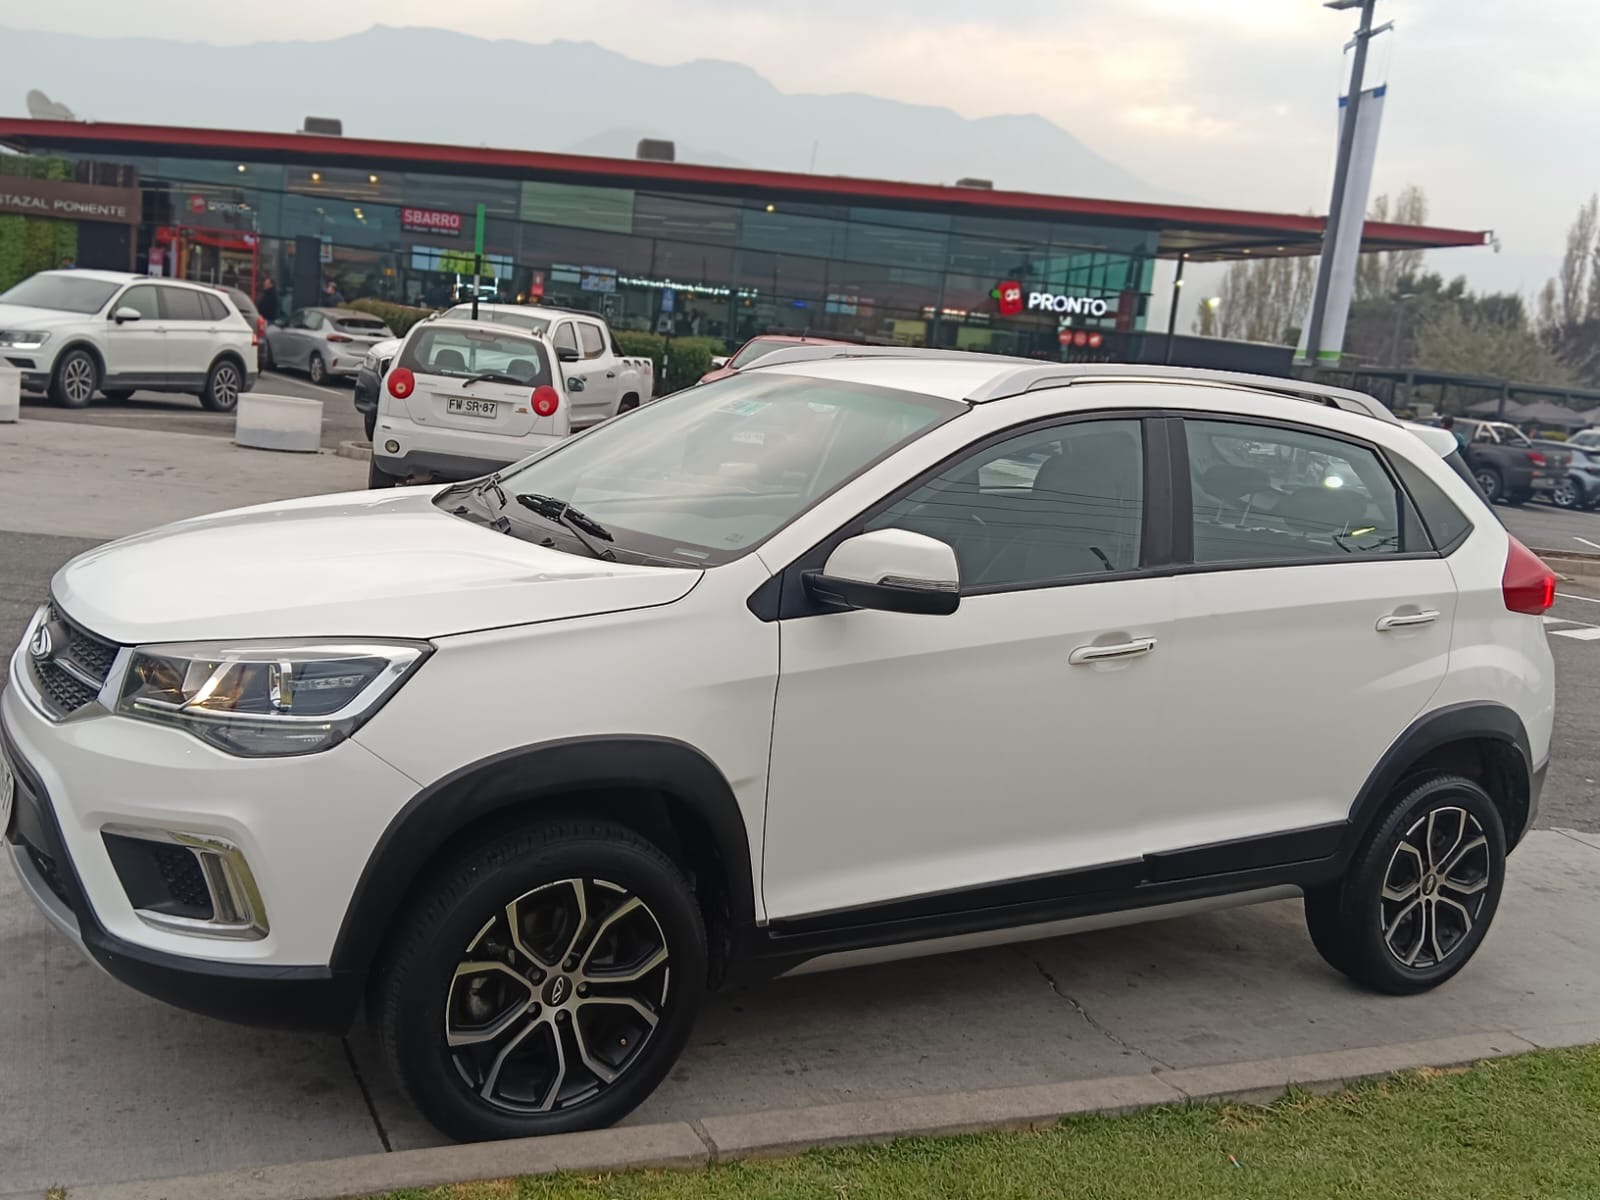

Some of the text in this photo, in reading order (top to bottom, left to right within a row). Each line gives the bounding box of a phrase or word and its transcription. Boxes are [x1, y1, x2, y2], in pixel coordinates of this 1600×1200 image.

[54, 200, 127, 217] PONIENTE
[404, 209, 460, 228] SBARRO
[1028, 292, 1107, 316] PRONTO
[449, 399, 463, 410] FW
